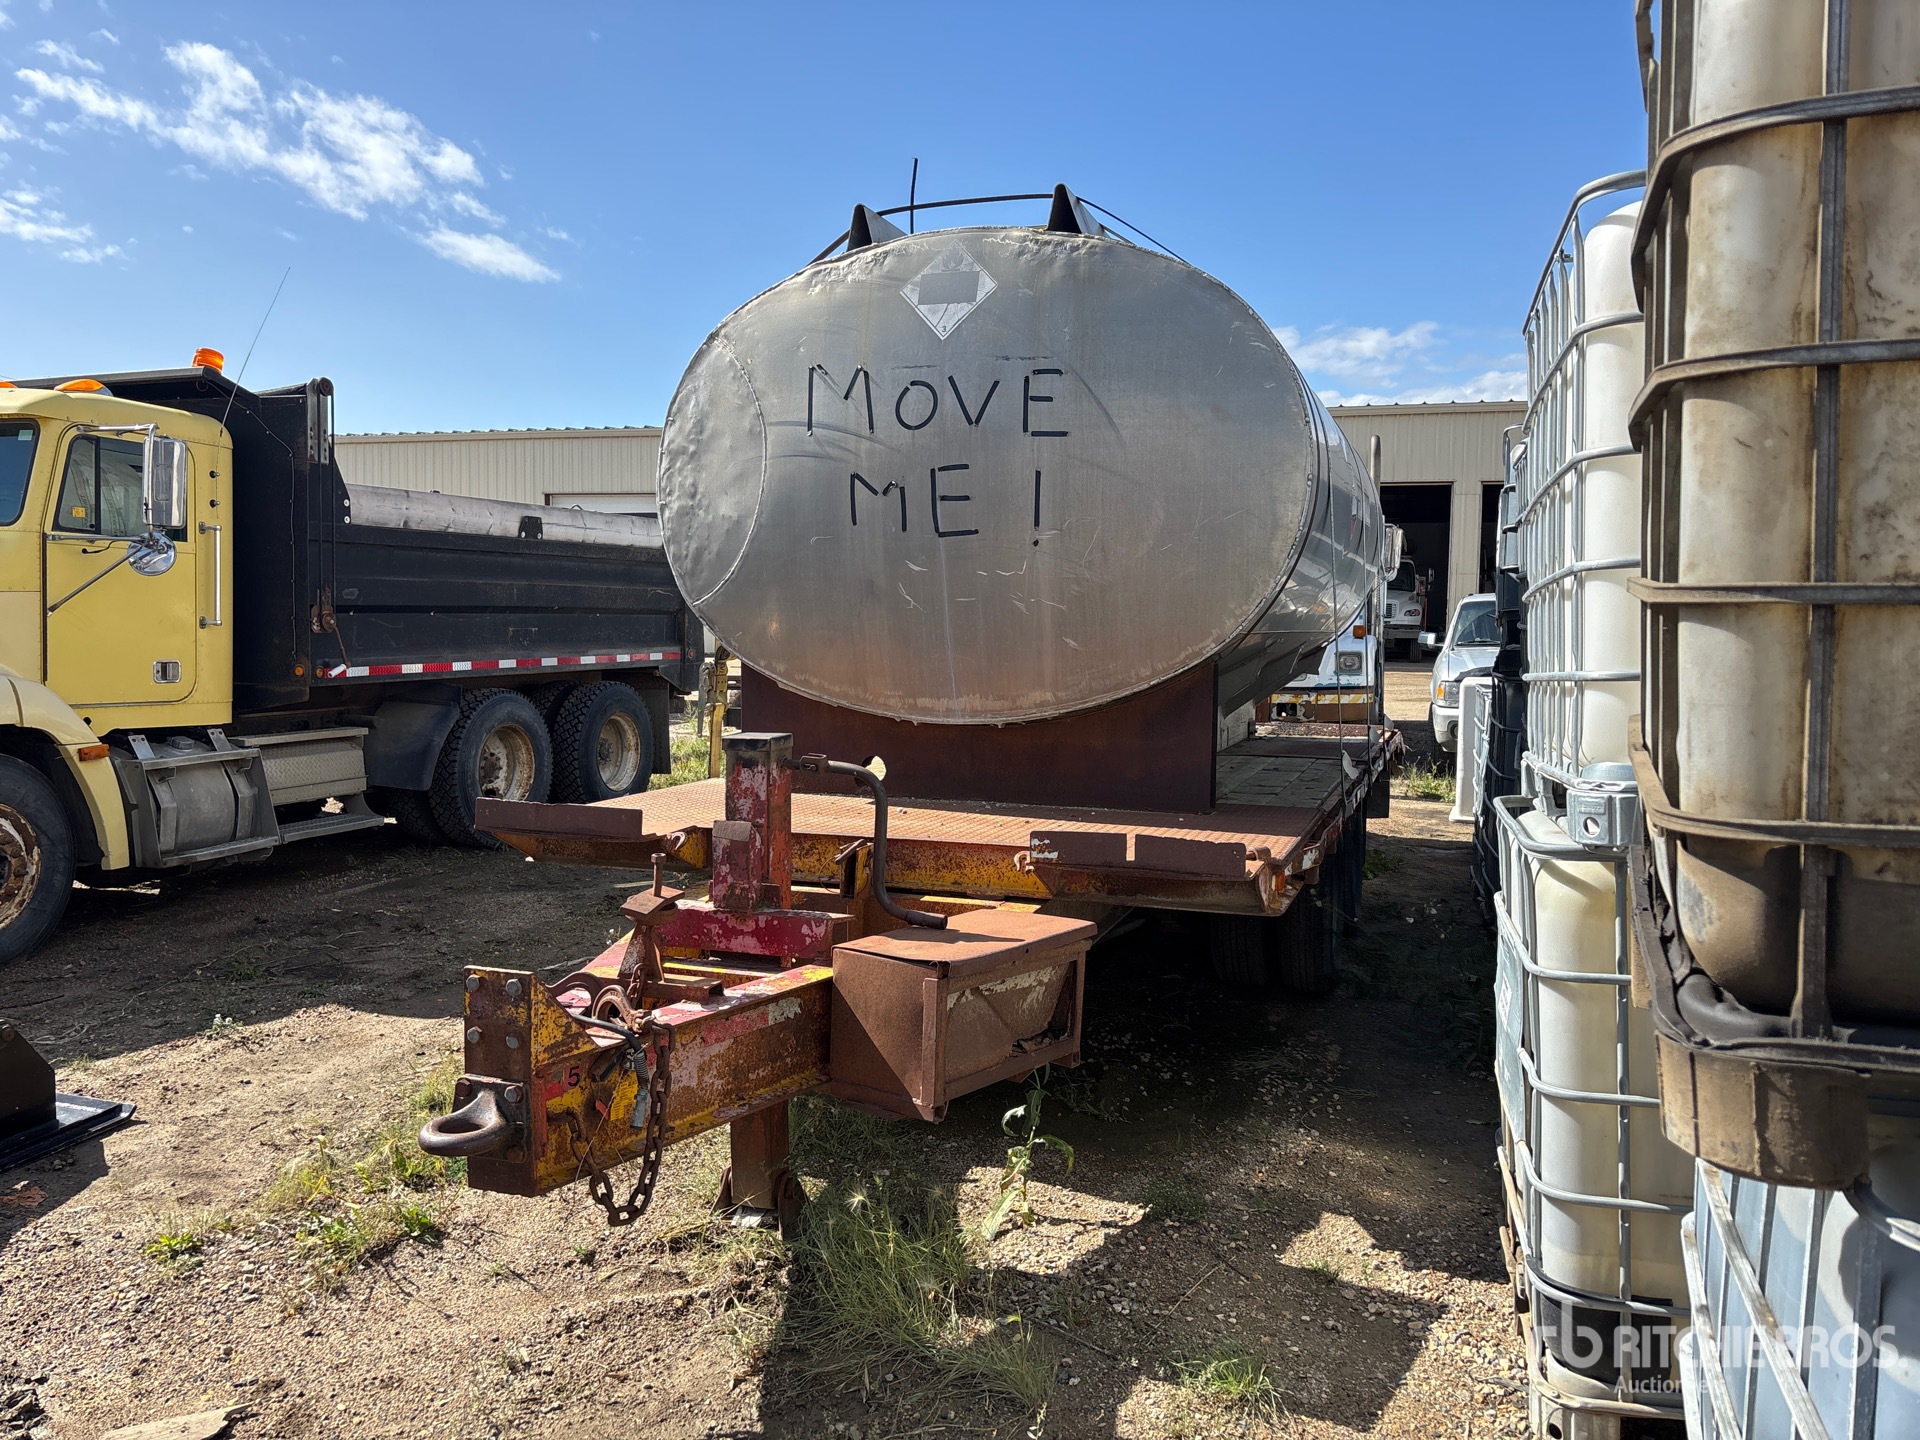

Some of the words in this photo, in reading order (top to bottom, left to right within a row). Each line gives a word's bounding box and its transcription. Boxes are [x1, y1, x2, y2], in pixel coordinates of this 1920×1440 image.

[941, 325, 947, 333] 3
[807, 364, 1069, 437] MOVE
[567, 1066, 581, 1087] 5
